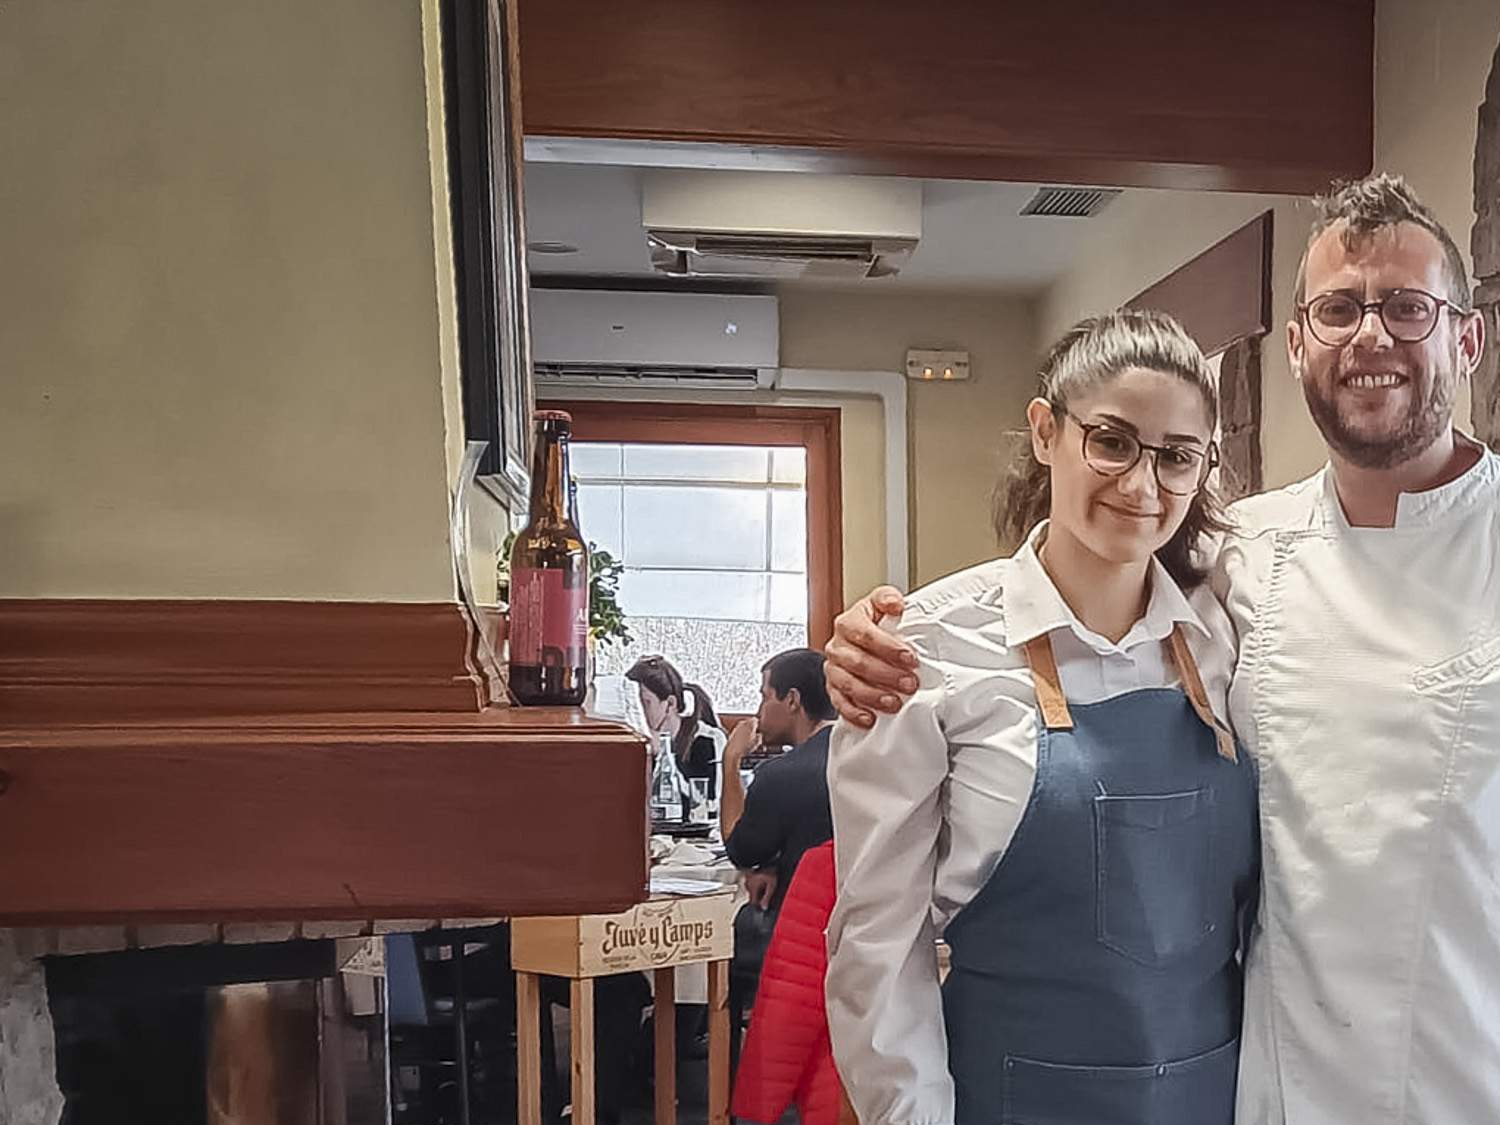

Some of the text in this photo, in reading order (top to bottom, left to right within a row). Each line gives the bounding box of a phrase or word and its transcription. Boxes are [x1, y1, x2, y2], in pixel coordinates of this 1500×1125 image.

[602, 915, 713, 955] Juvé y Camps
